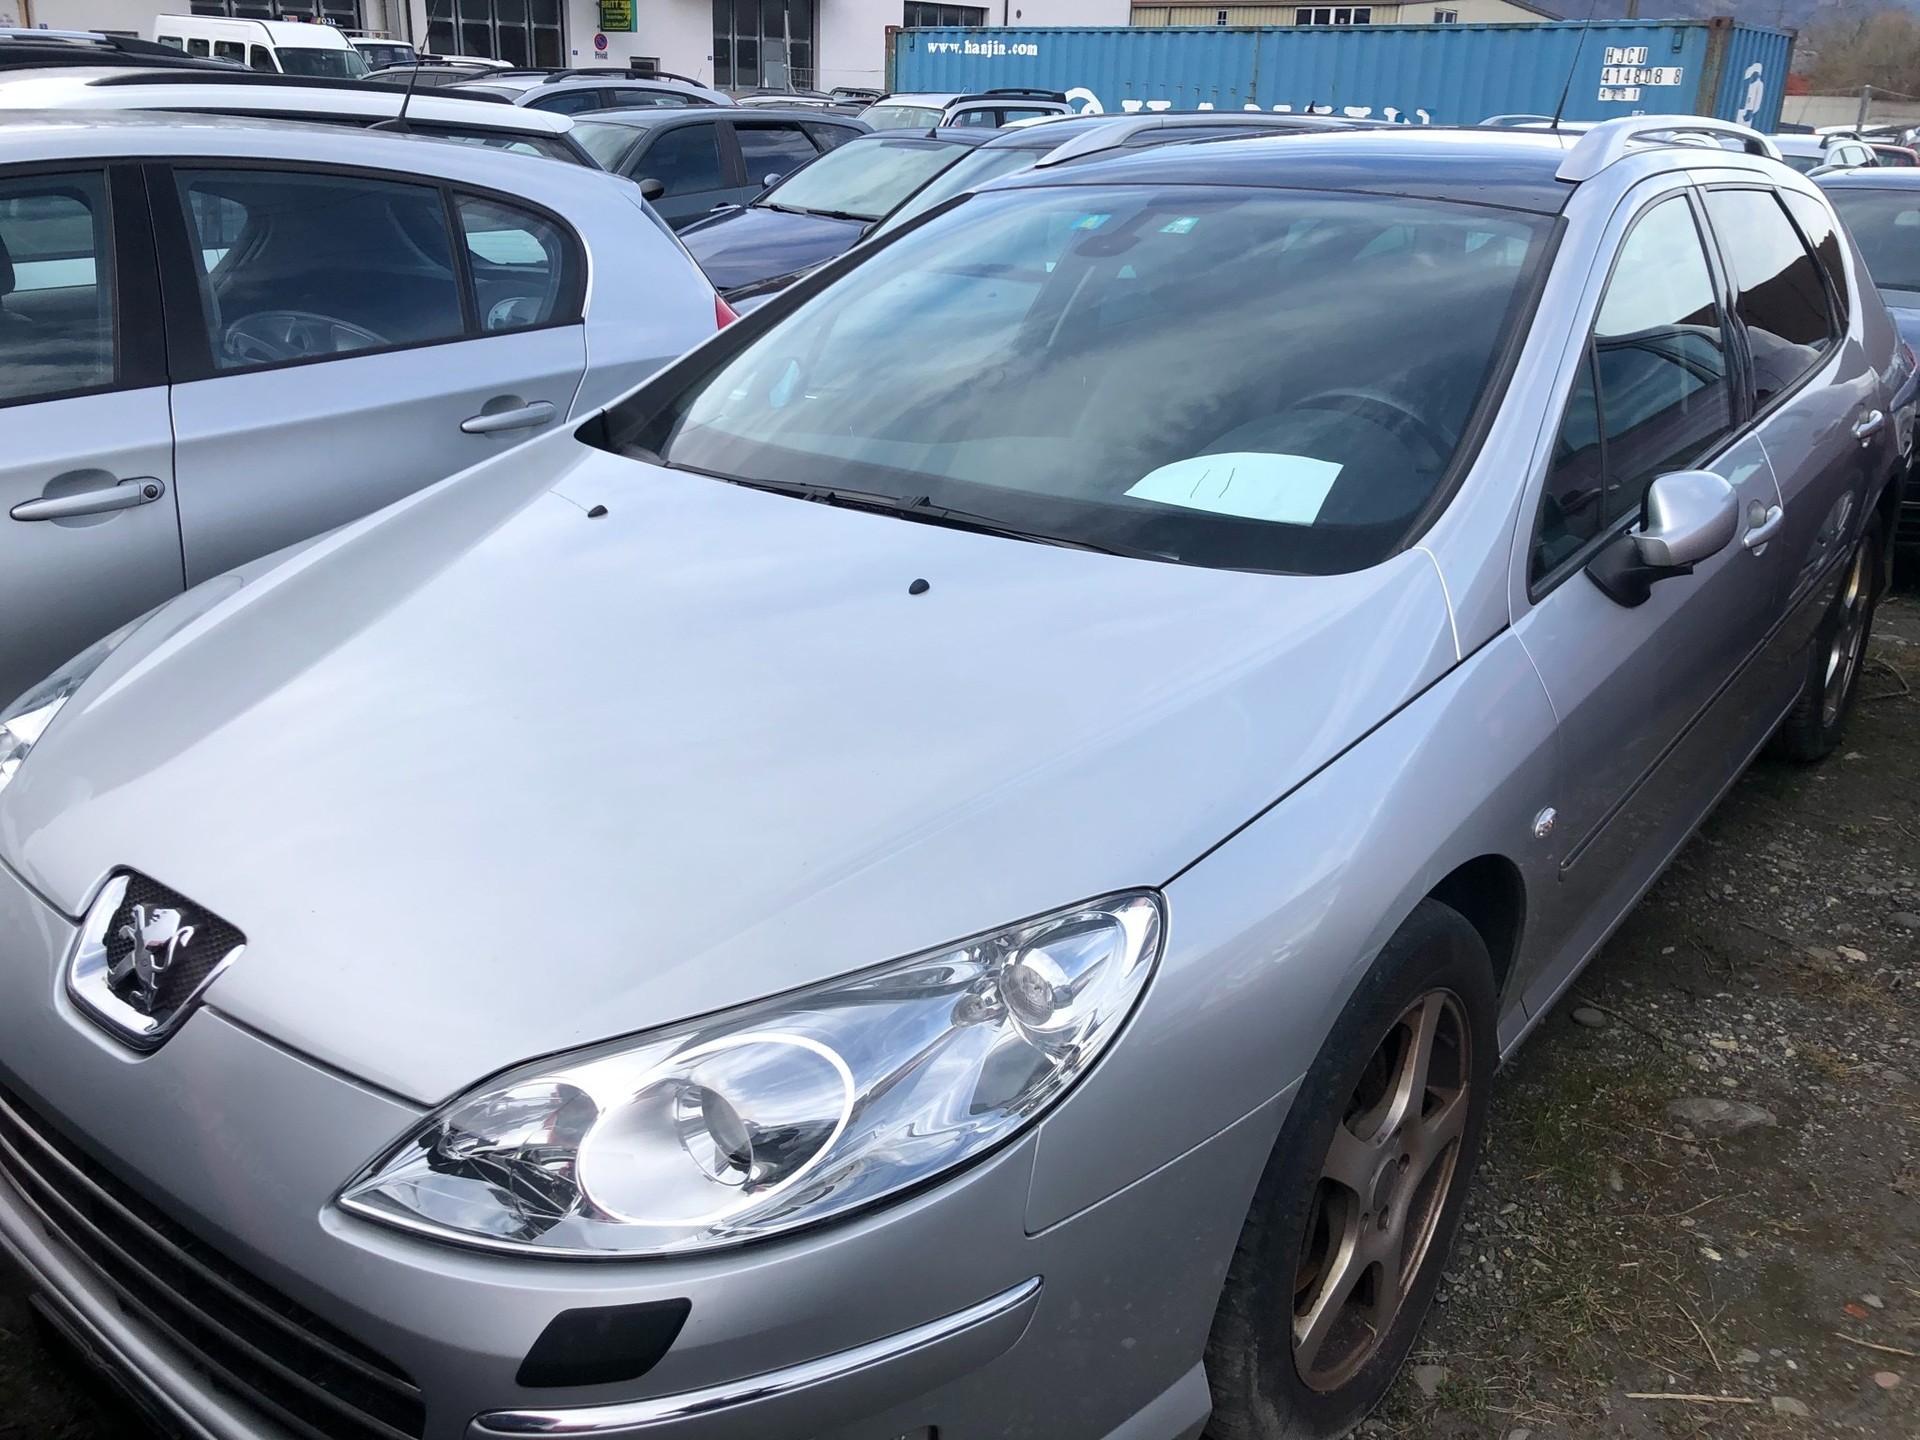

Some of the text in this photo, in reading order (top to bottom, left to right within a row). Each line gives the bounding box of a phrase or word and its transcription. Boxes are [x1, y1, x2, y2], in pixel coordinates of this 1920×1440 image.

[927, 39, 1038, 59] www.hanjin.com
[1605, 47, 1647, 64] HJCU
[1602, 68, 1682, 84] 414808 8
